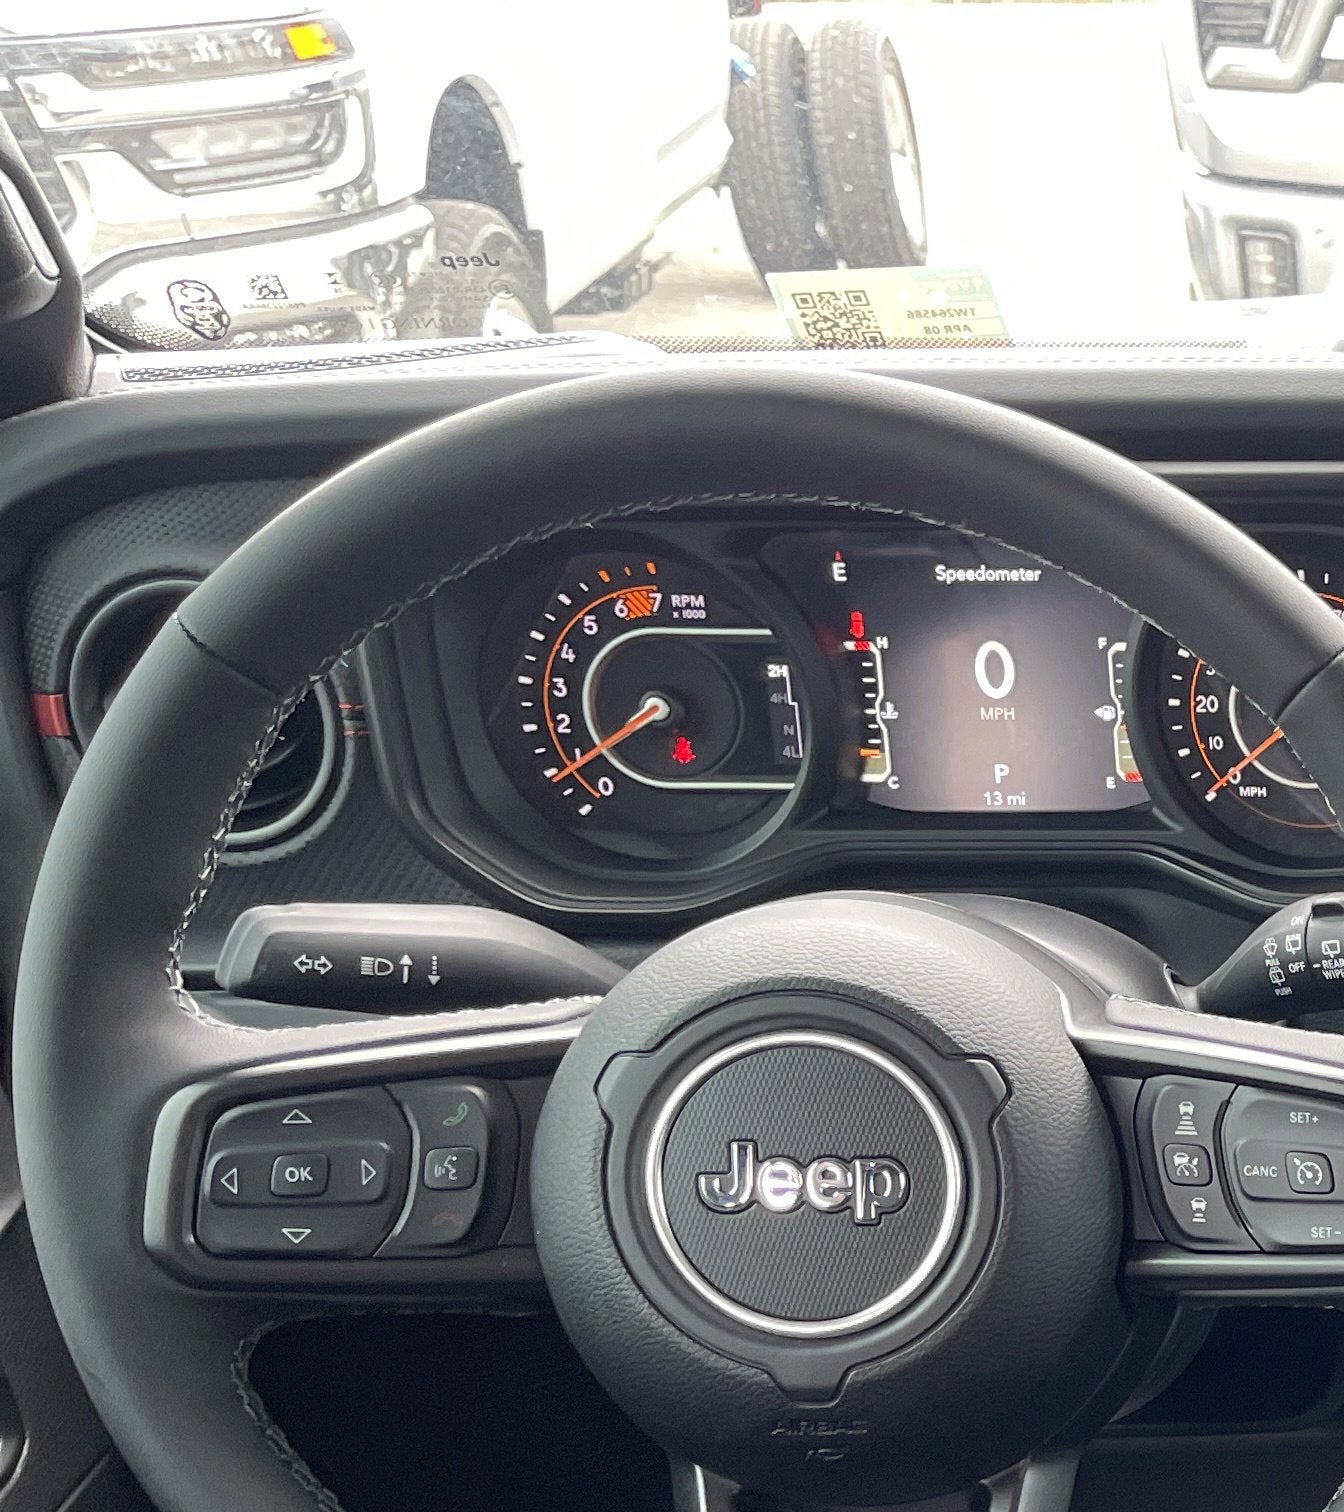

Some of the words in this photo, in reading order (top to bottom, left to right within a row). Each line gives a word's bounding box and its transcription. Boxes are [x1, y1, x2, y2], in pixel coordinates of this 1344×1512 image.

[832, 562, 847, 582] E
[934, 565, 1042, 584] Speedometer
[648, 593, 662, 613] 7
[671, 594, 705, 608] RPM
[614, 600, 628, 618] 6
[682, 609, 706, 619] 1000
[582, 615, 598, 635] 5
[876, 636, 889, 650] H
[1097, 637, 1108, 650] F
[560, 643, 576, 662] 4
[768, 664, 786, 677] 2H
[974, 640, 1015, 700] 0
[552, 677, 568, 698] 3
[1196, 695, 1219, 713] 20
[980, 707, 1015, 721] MPH
[556, 713, 571, 733] 2
[783, 723, 794, 736] N
[1208, 736, 1224, 751] 10
[994, 764, 1009, 784] P
[598, 776, 614, 796] 0
[887, 777, 900, 790] C
[1106, 776, 1116, 789] E
[1239, 785, 1267, 798] MPH
[984, 792, 1003, 806] 13
[1007, 792, 1026, 806] mi
[1290, 914, 1305, 926] ON
[1288, 961, 1306, 974] OFF
[1289, 1111, 1320, 1125] SET+
[284, 1166, 312, 1183] OK
[1243, 1164, 1278, 1178] CANC
[698, 1138, 912, 1226] Jeep
